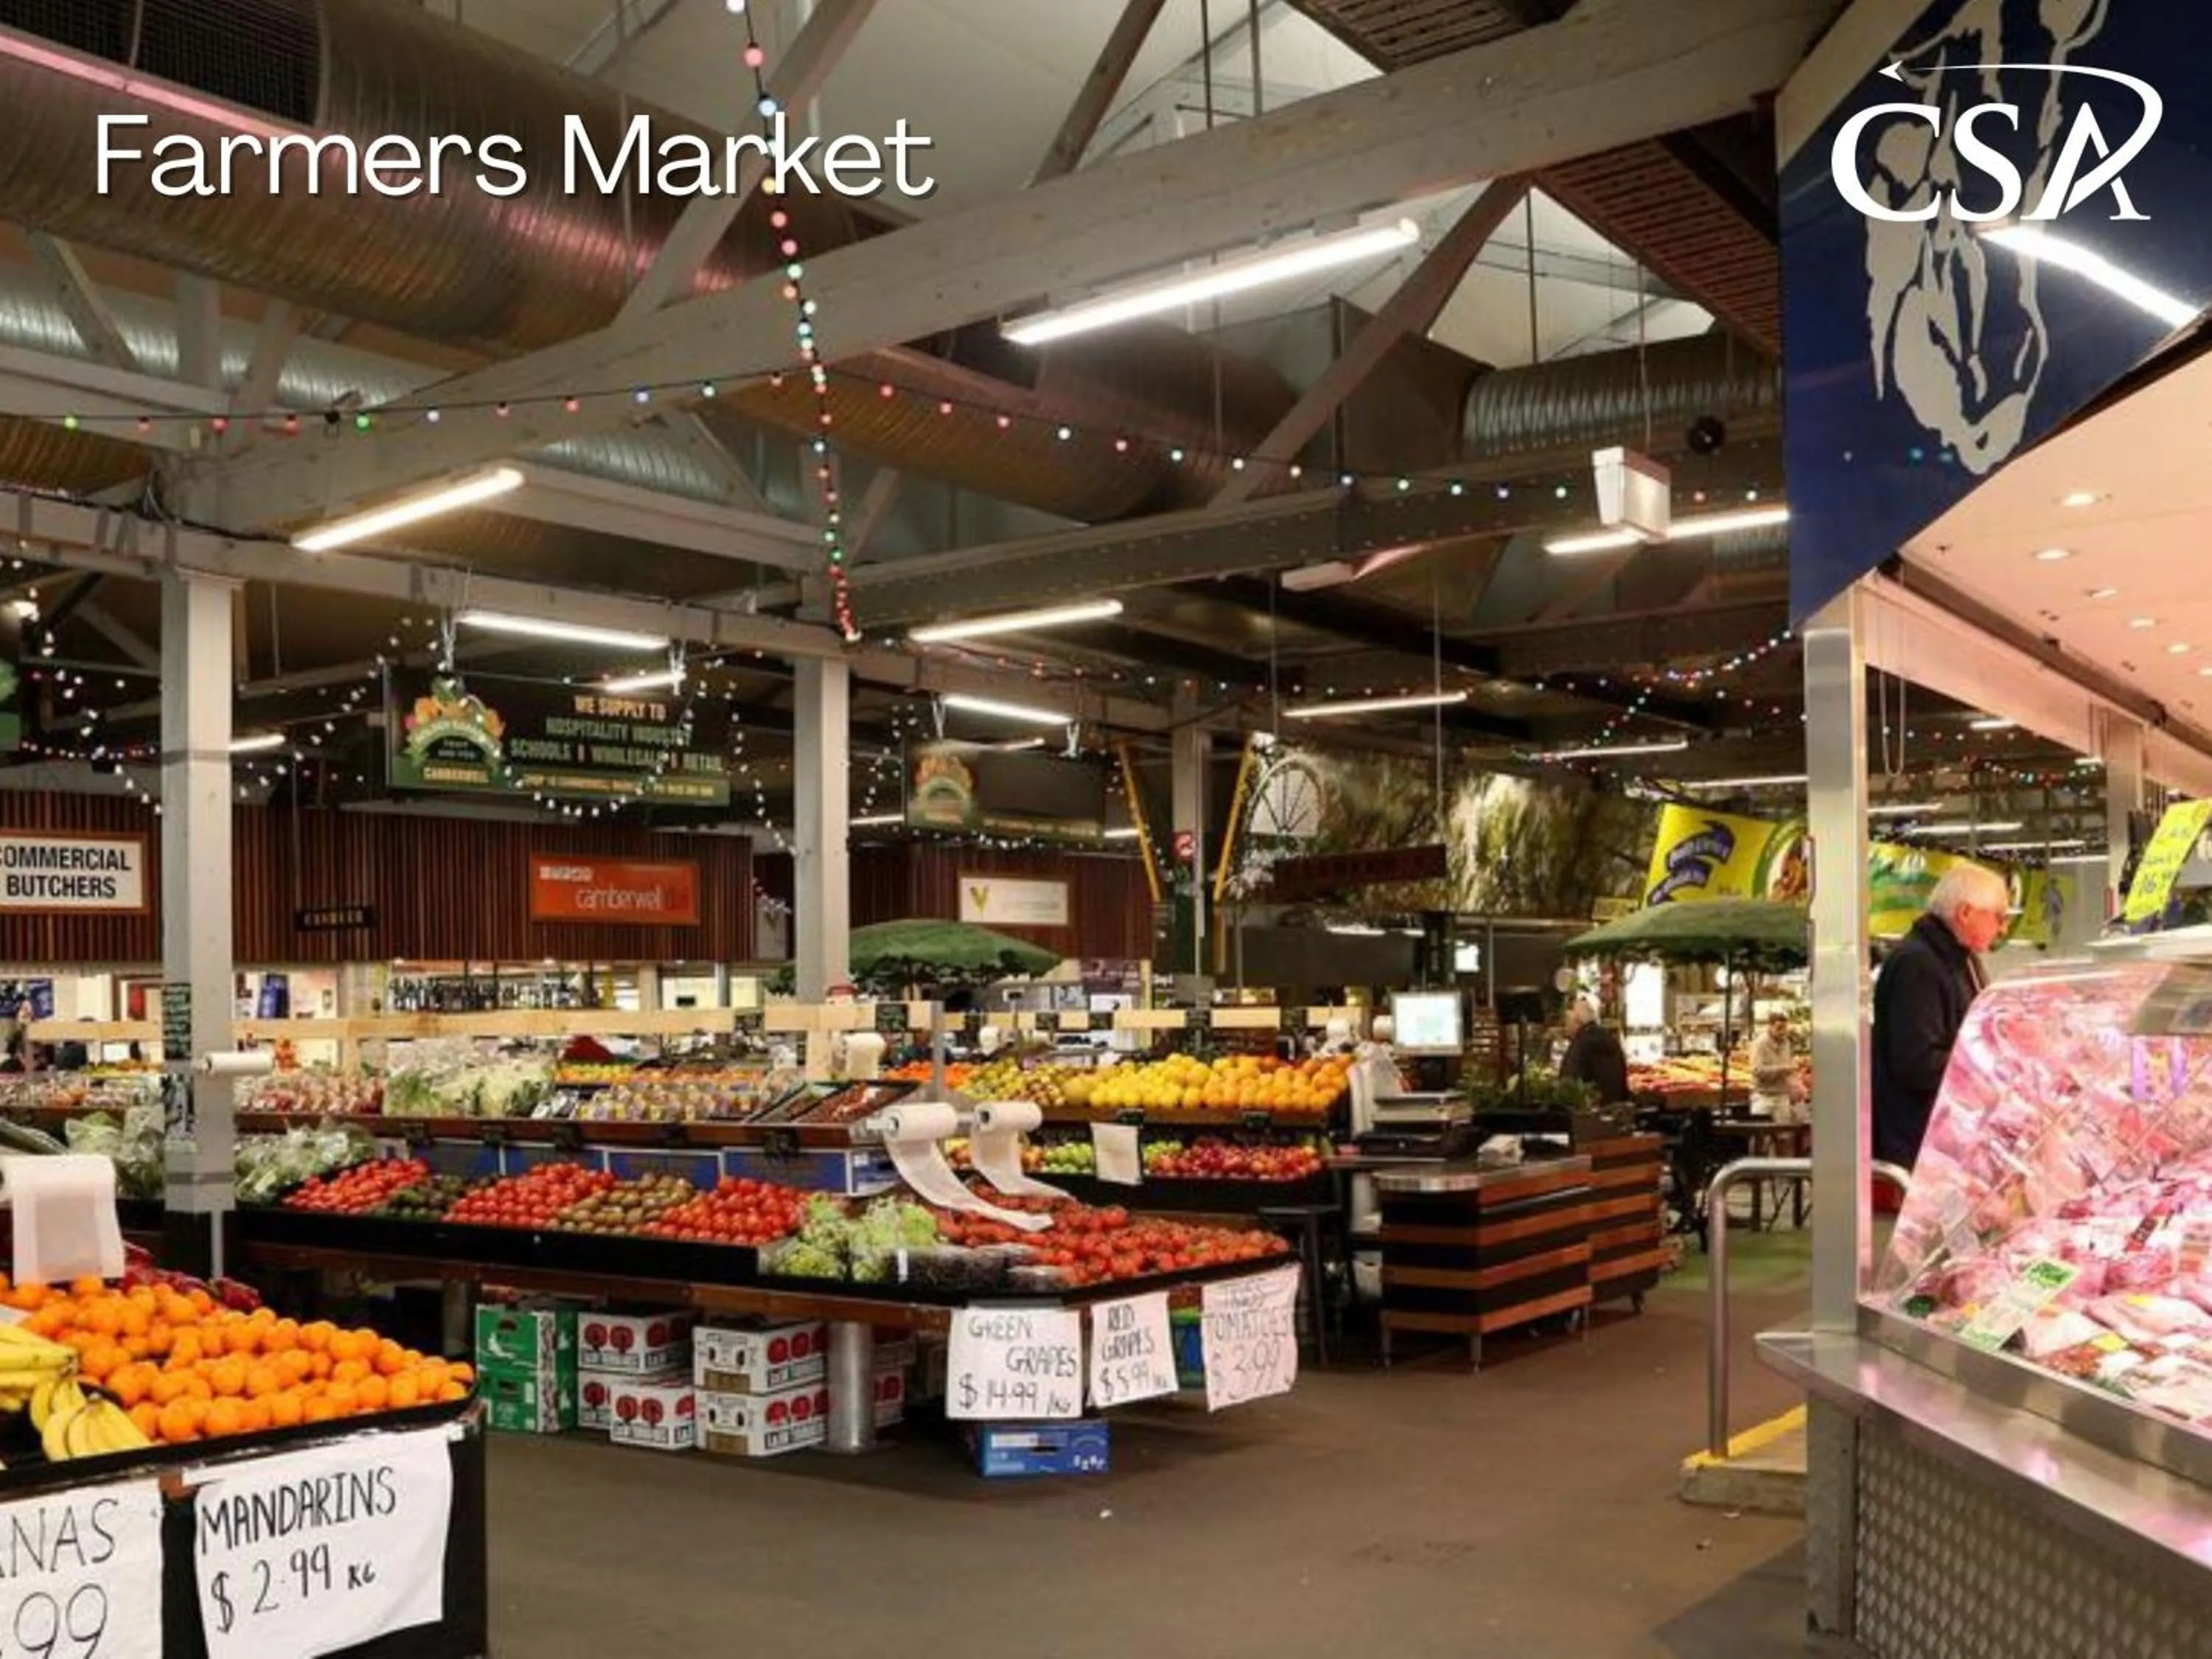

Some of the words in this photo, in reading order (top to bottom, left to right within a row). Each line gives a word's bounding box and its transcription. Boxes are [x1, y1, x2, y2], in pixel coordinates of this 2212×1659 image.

[0, 845, 132, 871] OMMERCIAL
[7, 874, 117, 899] BUTCHERS
[968, 1315, 1033, 1340] GREEN
[1006, 1344, 1077, 1377] GRAPES
[201, 1467, 397, 1555] MANDARINS
[0, 1498, 119, 1578] NAS
